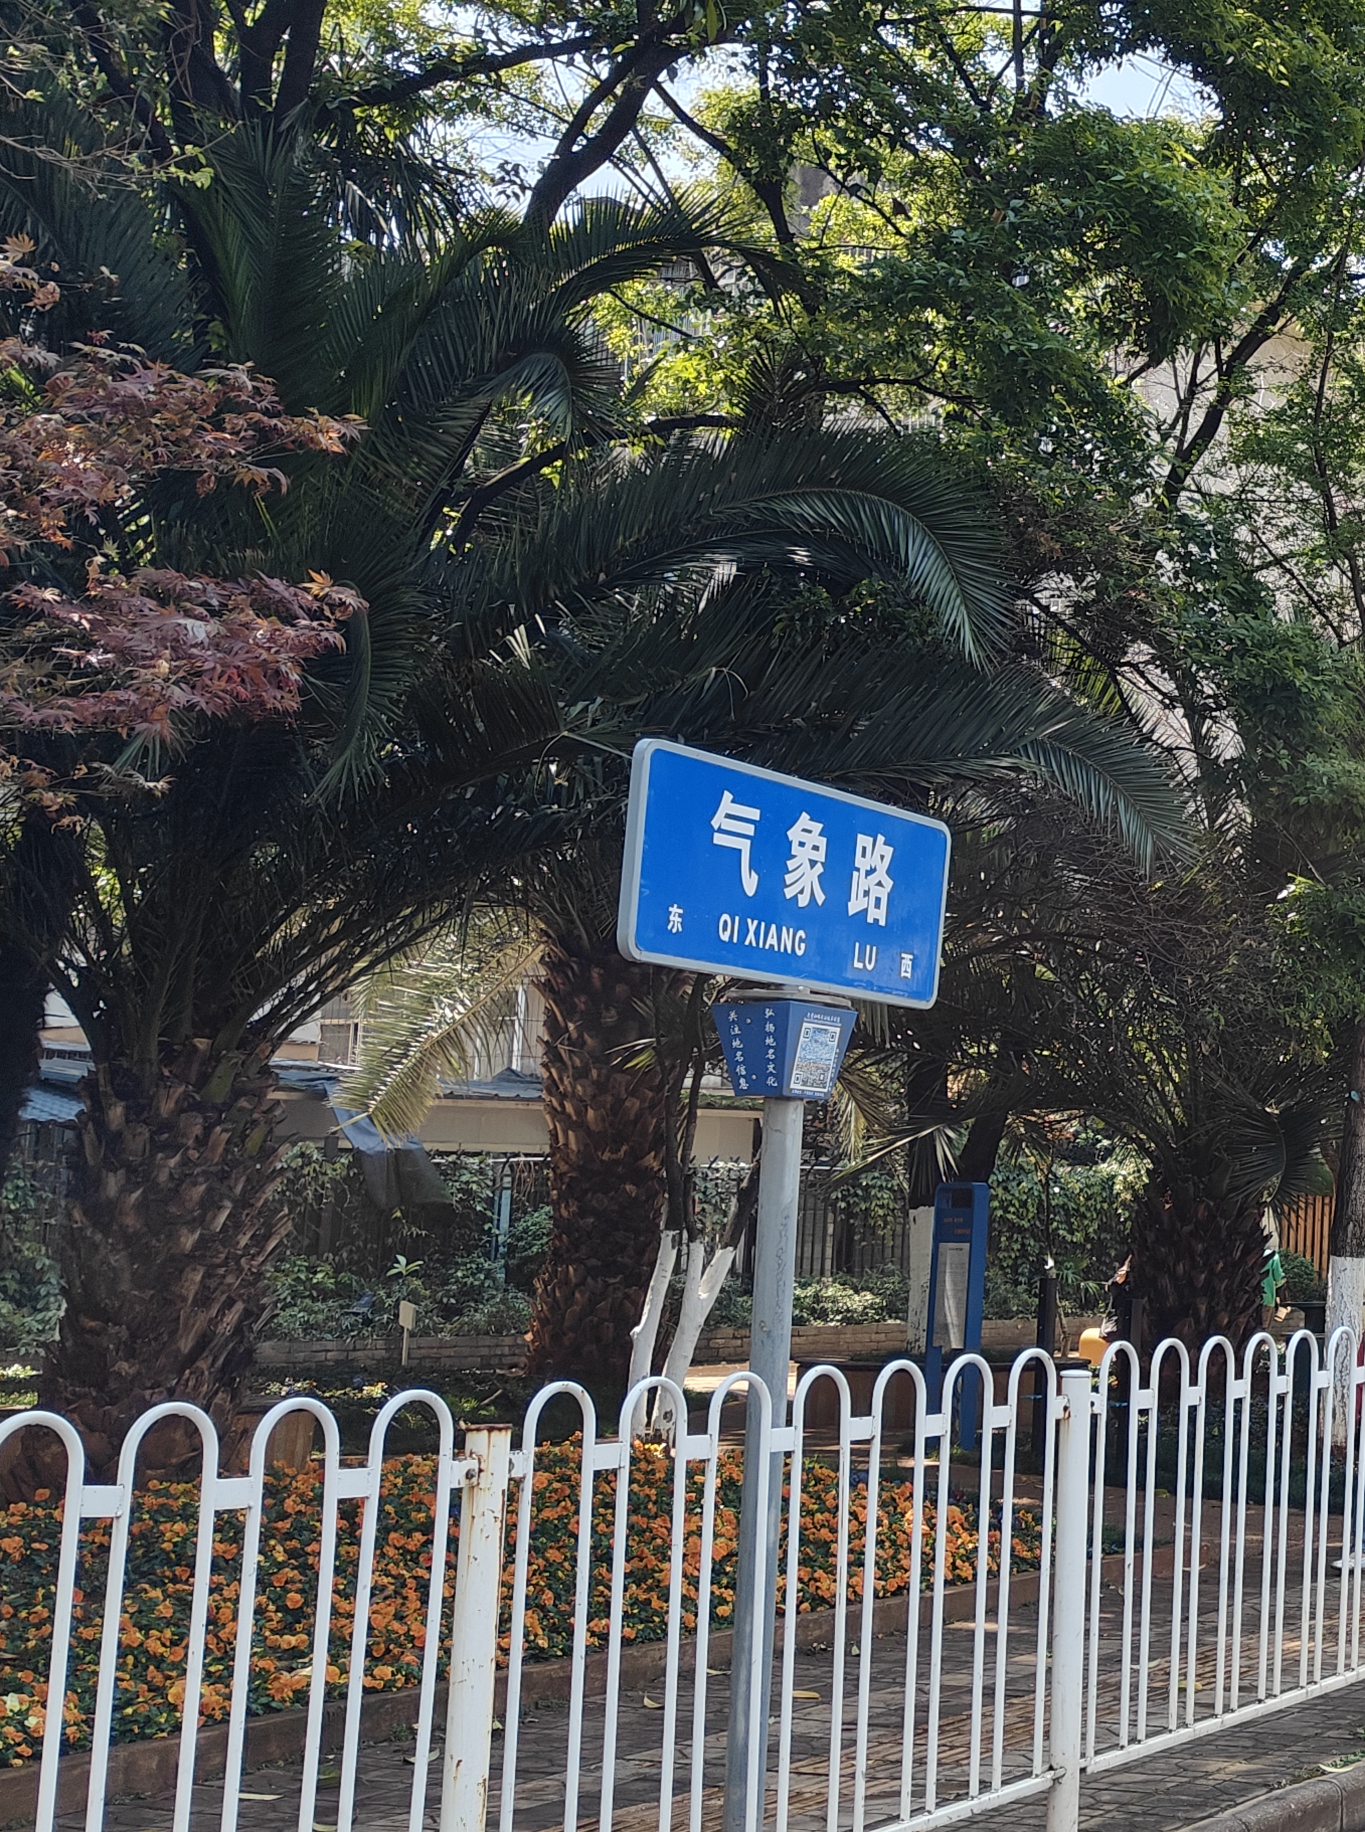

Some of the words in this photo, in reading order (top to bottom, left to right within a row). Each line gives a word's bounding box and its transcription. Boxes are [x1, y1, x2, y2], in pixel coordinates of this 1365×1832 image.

[710, 789, 894, 927] 气象路
[667, 904, 684, 934] 东
[718, 913, 740, 944] QI
[744, 917, 807, 957] XIANG
[853, 942, 877, 971] LU
[900, 952, 914, 979] 西
[728, 1009, 750, 1090] 关注地名信息
[764, 1007, 778, 1087] 弘扬地名文化
